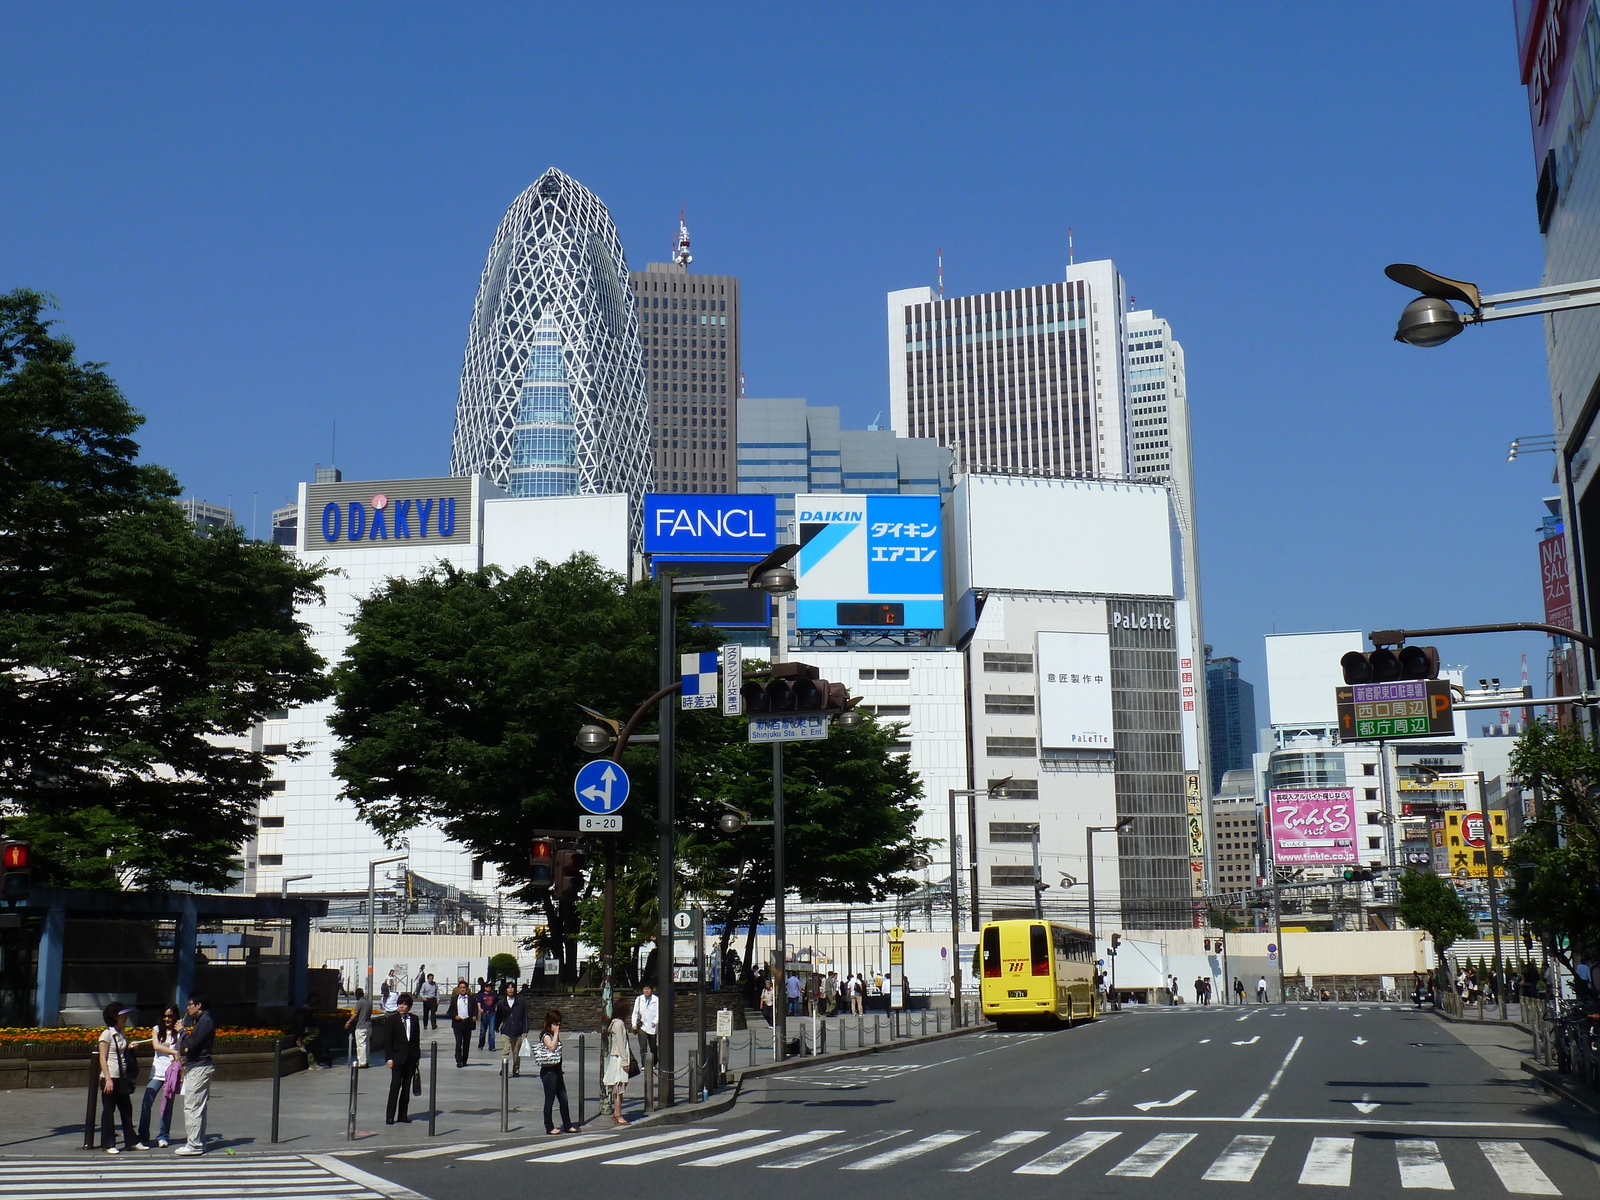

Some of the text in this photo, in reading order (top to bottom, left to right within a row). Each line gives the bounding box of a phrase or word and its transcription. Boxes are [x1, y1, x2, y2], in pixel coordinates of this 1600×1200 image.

[322, 494, 455, 541] ODAKYU
[656, 509, 766, 537] FANCL
[800, 511, 862, 521] DAIKIN
[871, 523, 937, 538] ダイキン
[871, 546, 937, 562] エアコン
[1542, 537, 1567, 566] NAI
[1113, 611, 1171, 630] PaLeTTe
[727, 647, 738, 712] スクランブル交差点
[1047, 673, 1104, 684] 意匠製作中
[1357, 683, 1423, 700] 新宿駅東口駐車場
[683, 694, 717, 709] 時差式
[1358, 701, 1425, 718] 西口周辺
[1430, 694, 1450, 719] P
[756, 716, 820, 731] 新宿駅東口
[1359, 718, 1426, 735] 都庁周辺
[752, 731, 781, 739] Shinjuku
[1072, 734, 1108, 743] PaLeTTe
[1304, 825, 1326, 836] net
[1467, 818, 1485, 841] 質
[1278, 852, 1355, 862] www.tinkle.co.jp
[893, 928, 899, 938] 1
